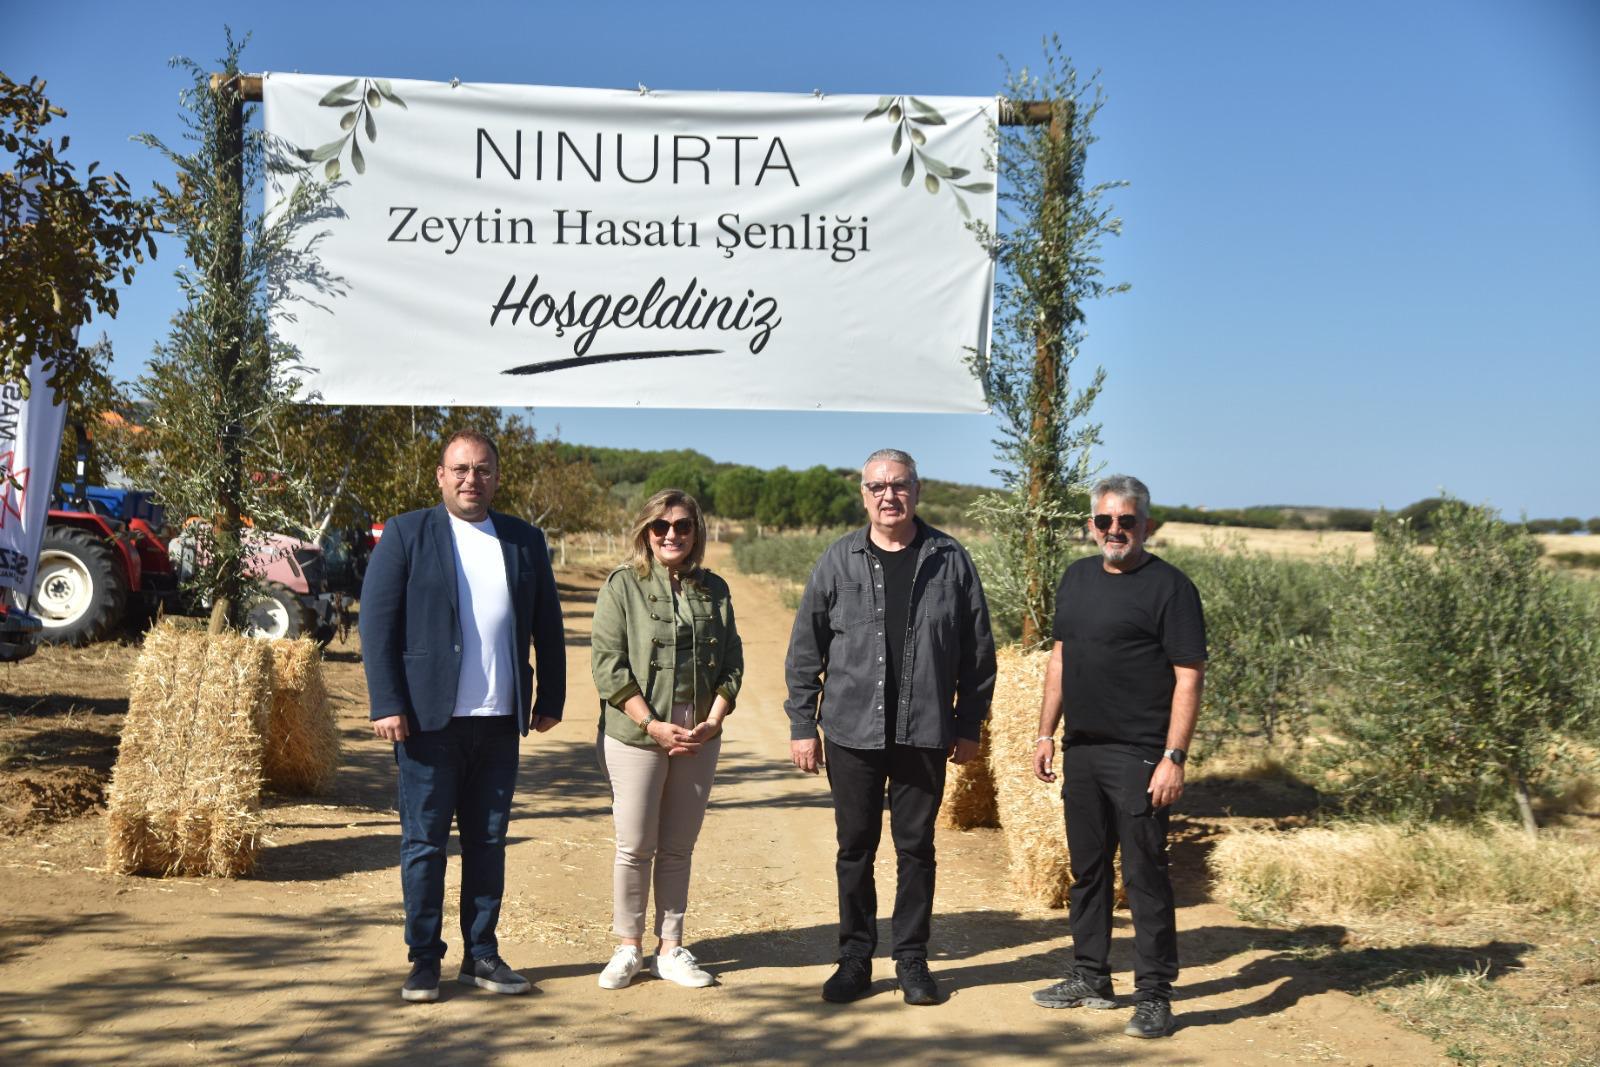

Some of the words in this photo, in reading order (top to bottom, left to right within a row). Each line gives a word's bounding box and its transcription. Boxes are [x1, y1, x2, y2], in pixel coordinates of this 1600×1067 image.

[476, 128, 800, 187] NINURTA
[387, 207, 535, 255] Zeytin
[553, 209, 699, 247] Hasatı
[715, 212, 870, 263] Şenliği
[490, 274, 783, 356] Hoşgeldiniz
